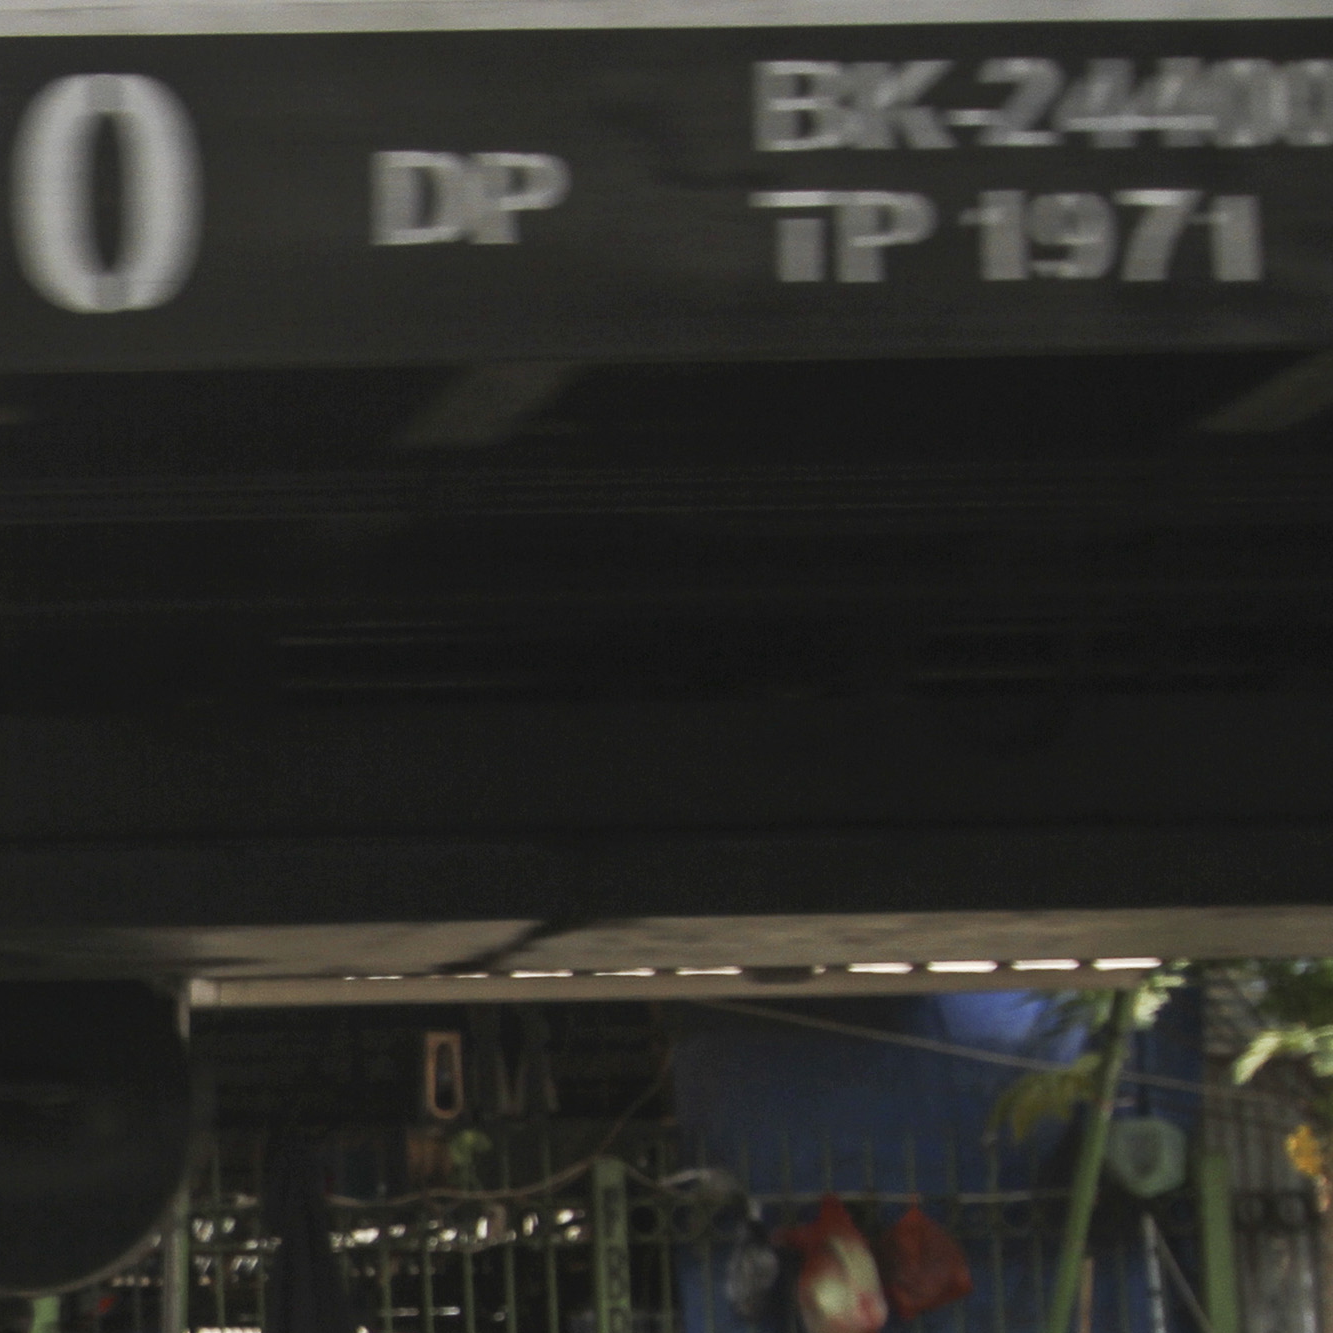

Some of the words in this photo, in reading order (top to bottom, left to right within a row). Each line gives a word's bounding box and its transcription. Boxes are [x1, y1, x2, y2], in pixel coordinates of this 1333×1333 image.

[371, 150, 570, 246] DP
[748, 190, 938, 283] TP
[958, 188, 1264, 282] 1971
